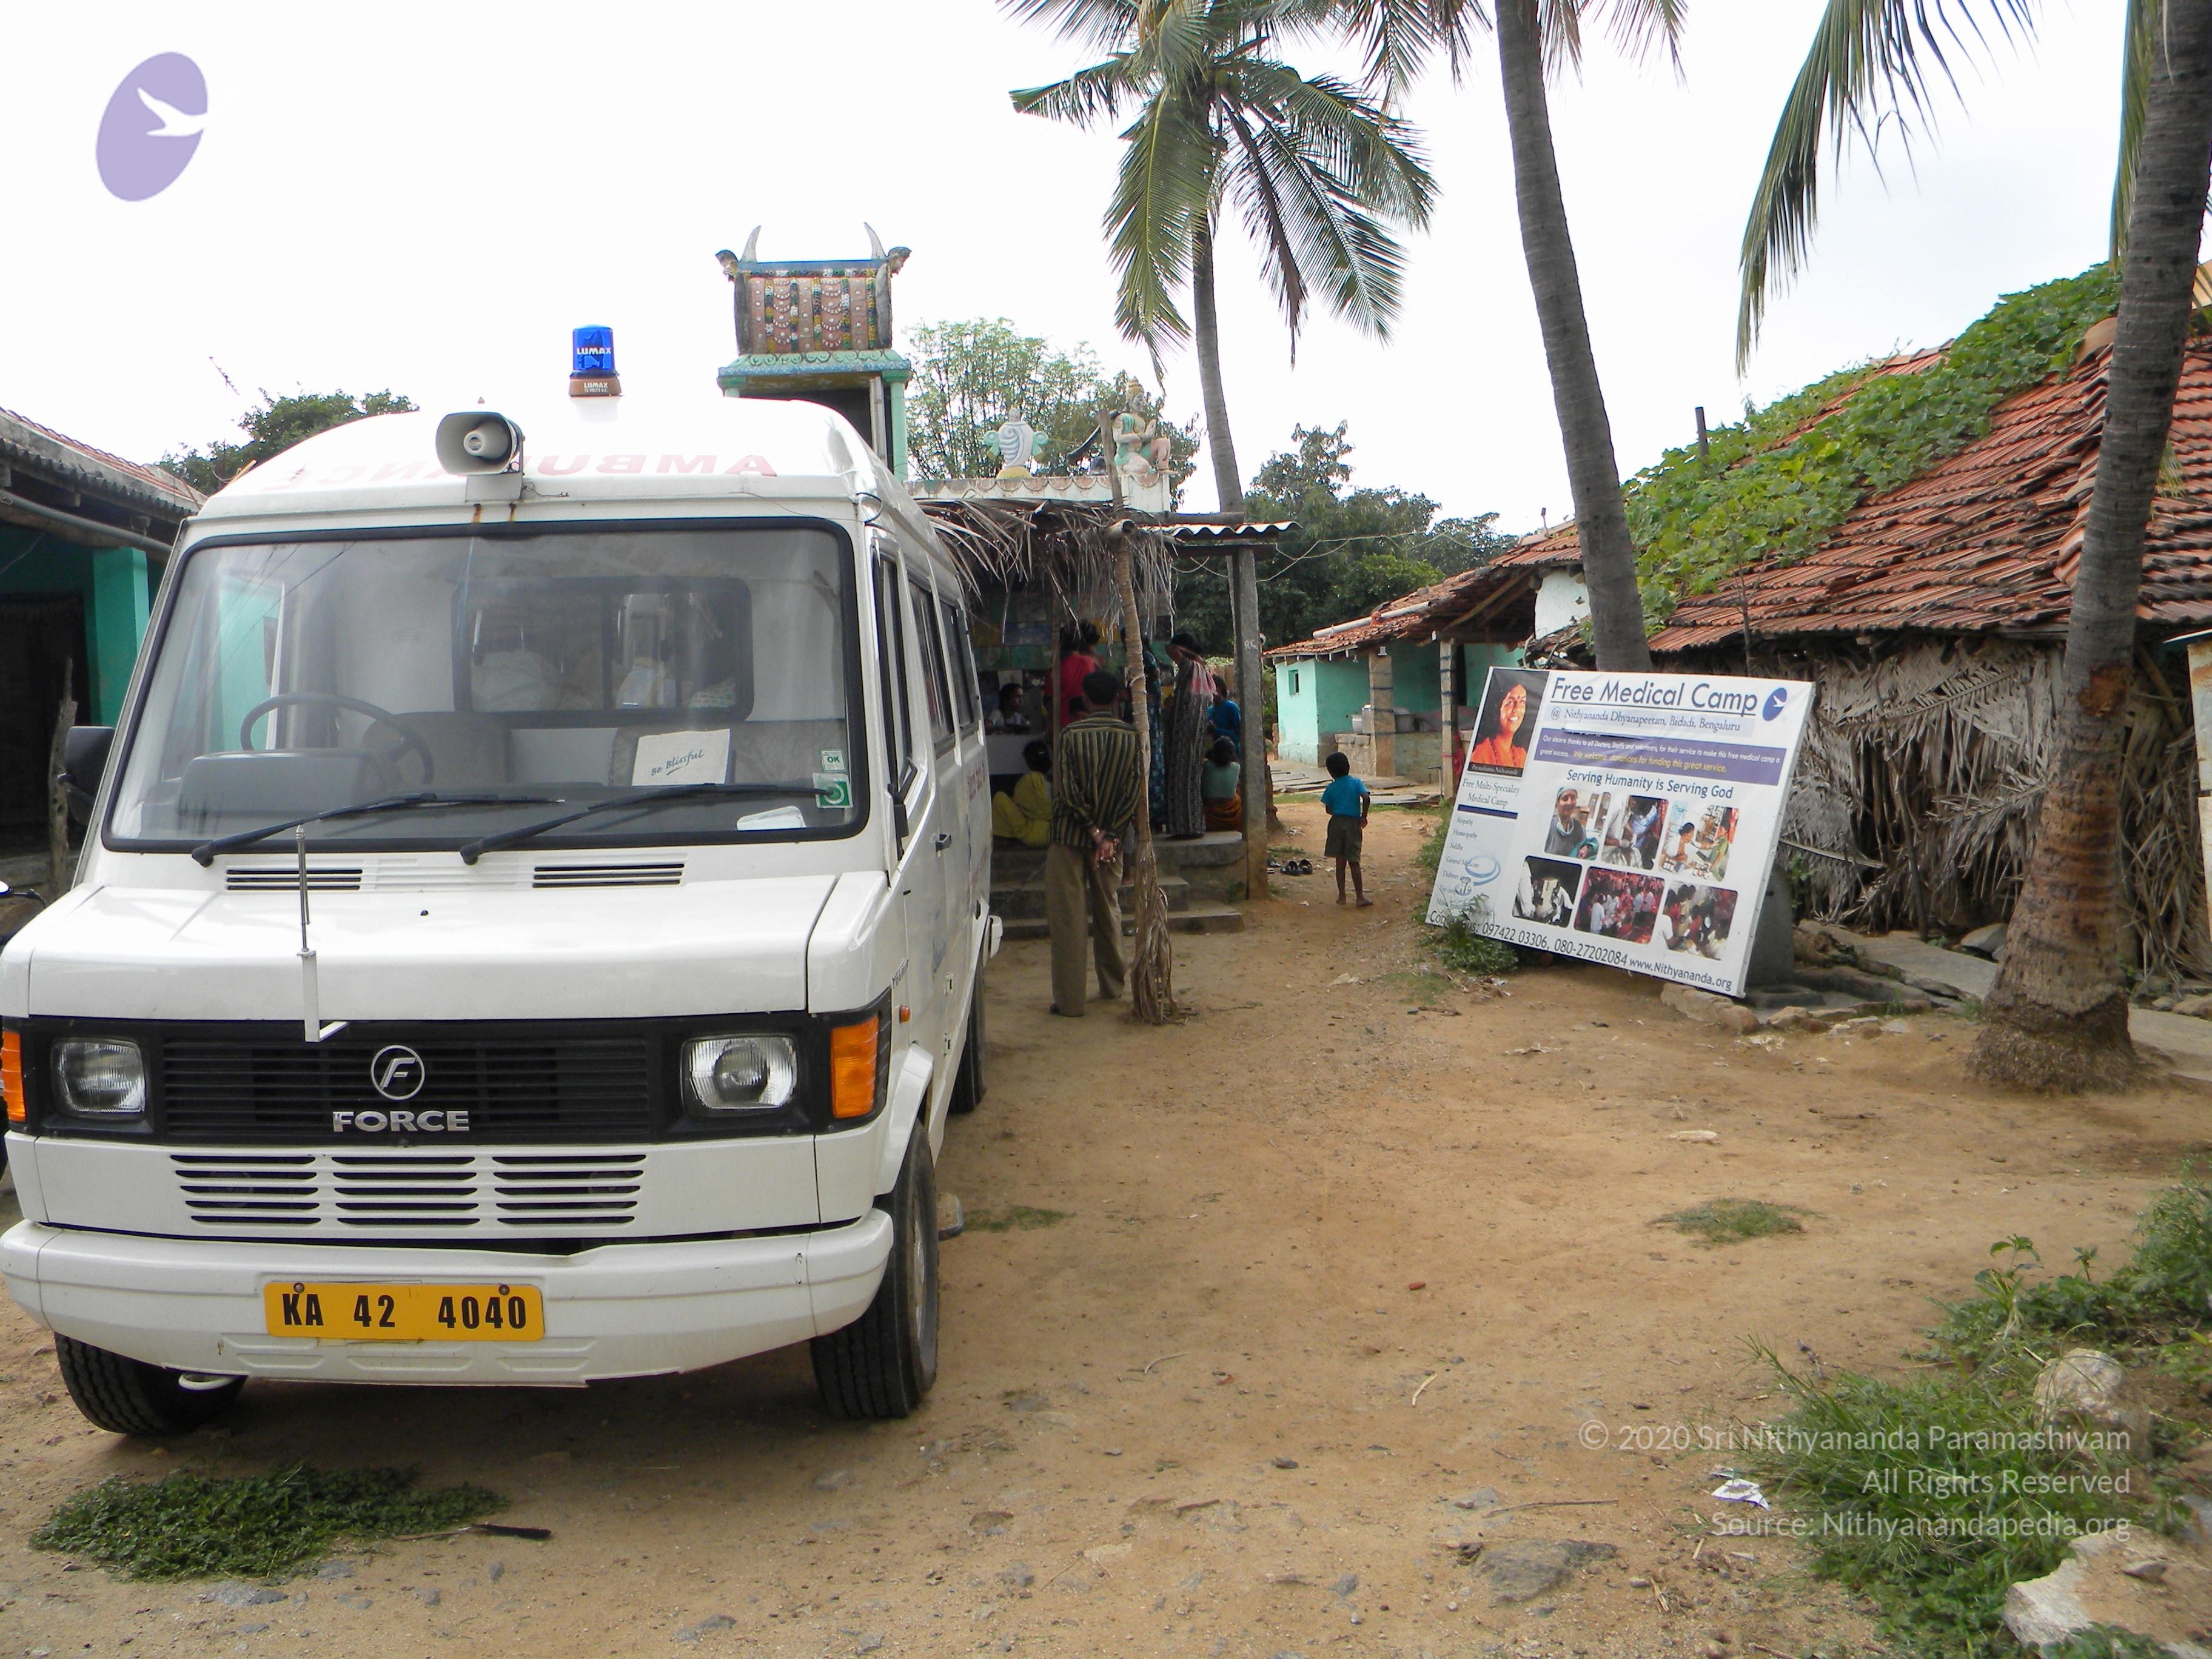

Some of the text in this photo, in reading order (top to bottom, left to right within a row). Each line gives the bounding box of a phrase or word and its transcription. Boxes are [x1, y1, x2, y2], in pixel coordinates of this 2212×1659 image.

[1552, 677, 1758, 717] Free Medical Camp
[1551, 707, 1561, 720] @
[1564, 709, 1608, 722] Nithyananda
[1610, 711, 1666, 728] Dhyanapeetam,
[1699, 717, 1740, 732] Bengaluru
[651, 749, 705, 777] Be Blissful
[1574, 750, 1583, 759] We
[1610, 754, 1638, 763] donations
[1638, 756, 1647, 765] for
[1649, 757, 1671, 768] funding
[1672, 759, 1683, 768] this
[1683, 761, 1702, 771] great
[1703, 763, 1727, 773] service.
[1739, 753, 1760, 762] medical
[1760, 756, 1775, 765] camp
[1463, 778, 1521, 797] Free Multi-Speciality
[1567, 769, 1734, 799] Serving Humanity is Serving God
[1467, 792, 1508, 809] Medical Camp
[1482, 922, 1516, 941] 097422
[1518, 930, 1549, 951] 03306,
[1553, 939, 1629, 967] 080-27202084
[1629, 959, 1732, 992] www.Nithyananda.org
[332, 1110, 470, 1133] FORCE
[282, 1293, 526, 1330] KA 42 4040
